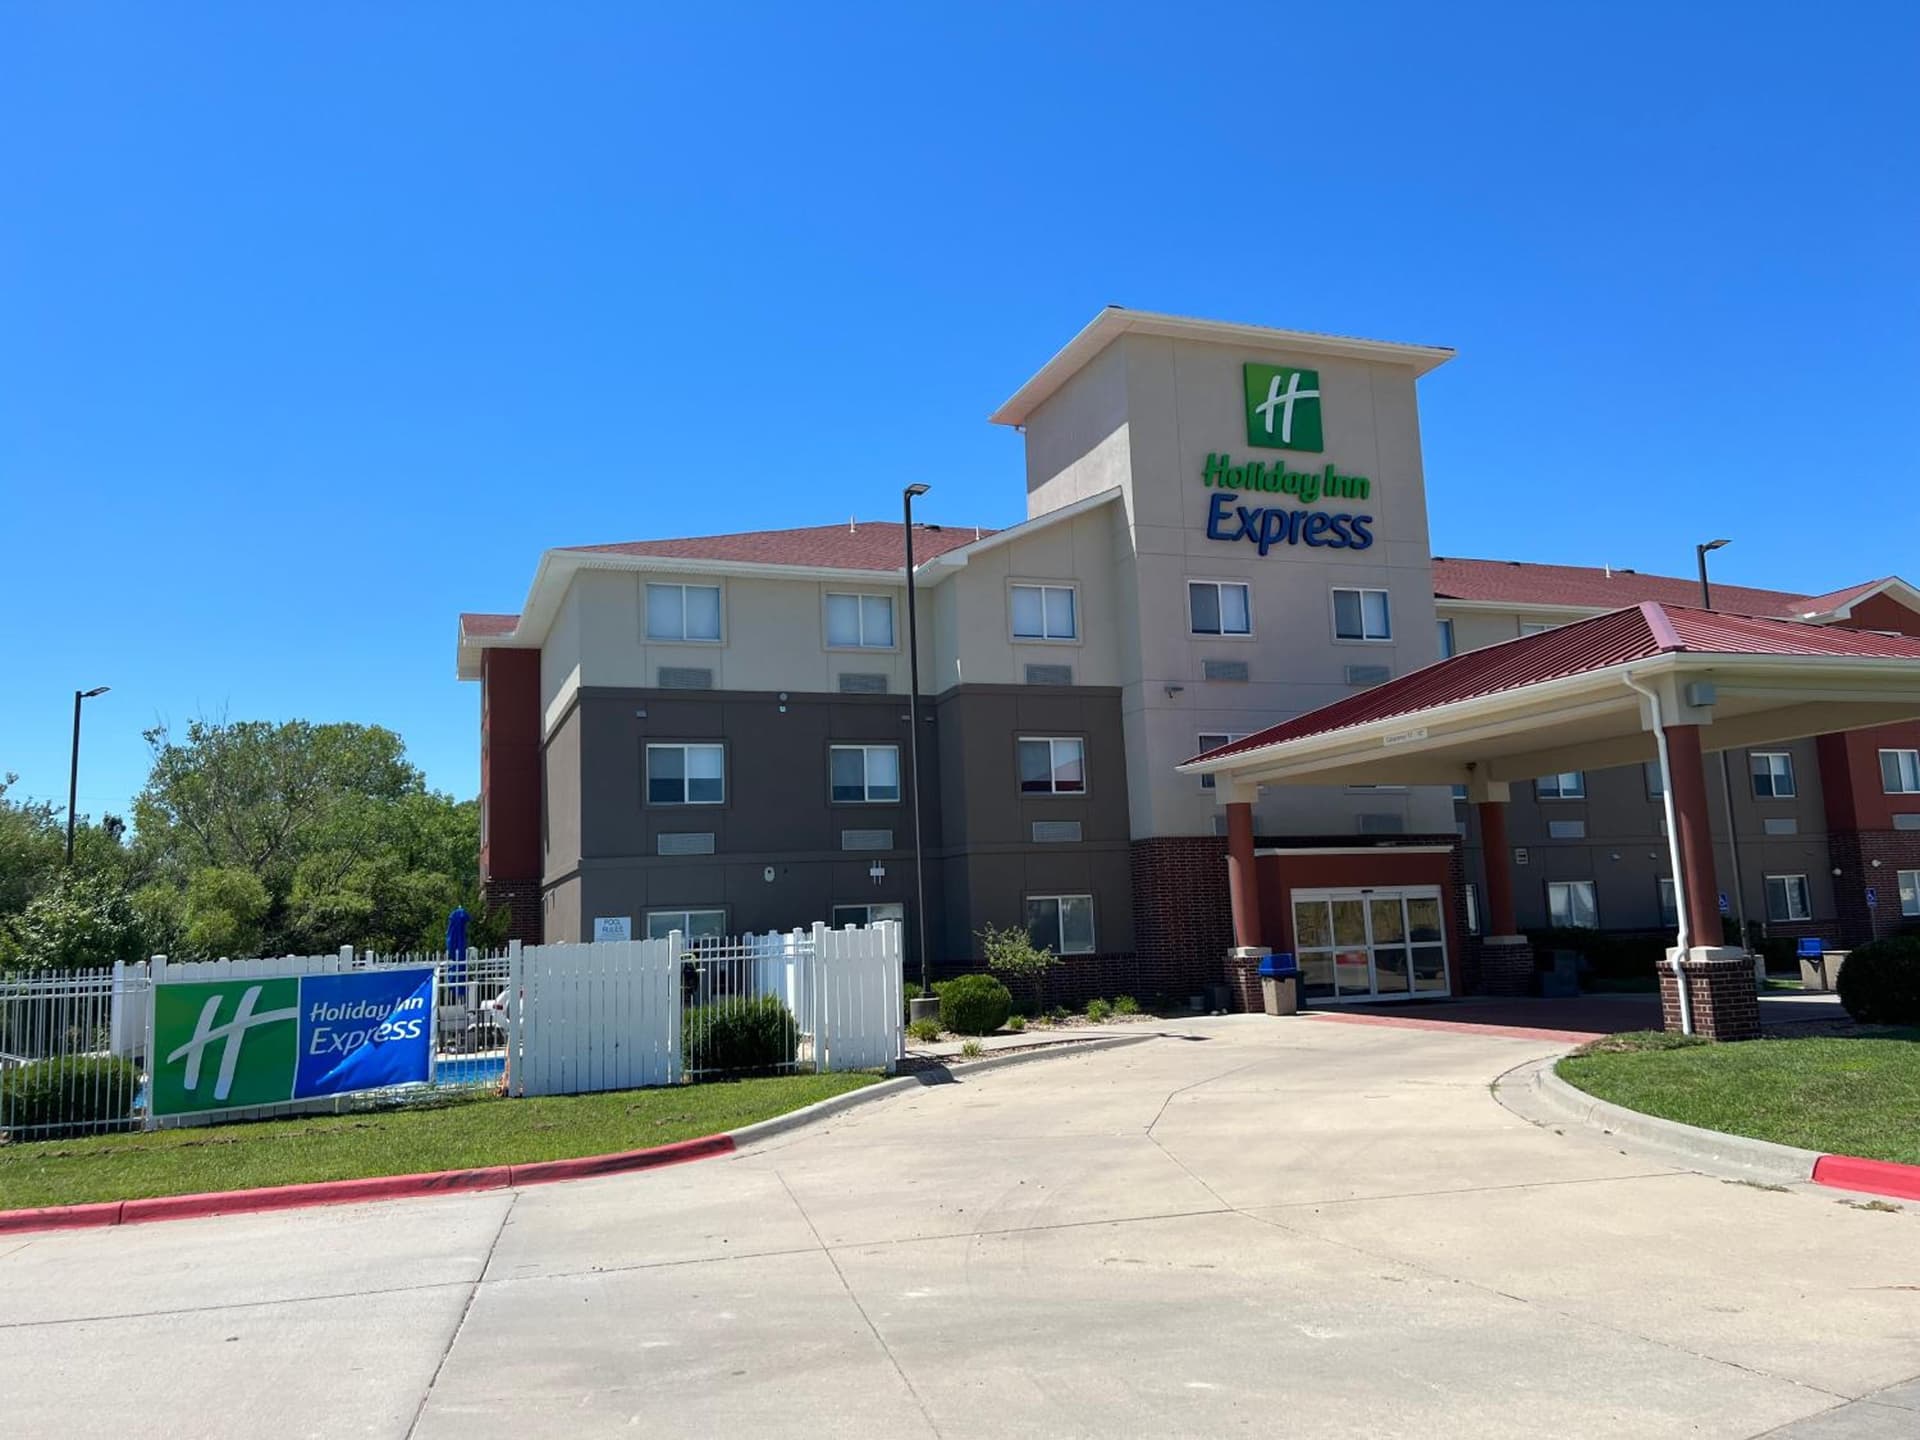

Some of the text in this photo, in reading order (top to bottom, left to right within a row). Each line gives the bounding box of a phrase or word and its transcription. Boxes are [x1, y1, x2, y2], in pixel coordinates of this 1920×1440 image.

[1202, 452, 1371, 504] Holiday Inn
[1206, 493, 1374, 556] Express
[309, 997, 424, 1022] Holiday Inn
[309, 1018, 423, 1056] Express
